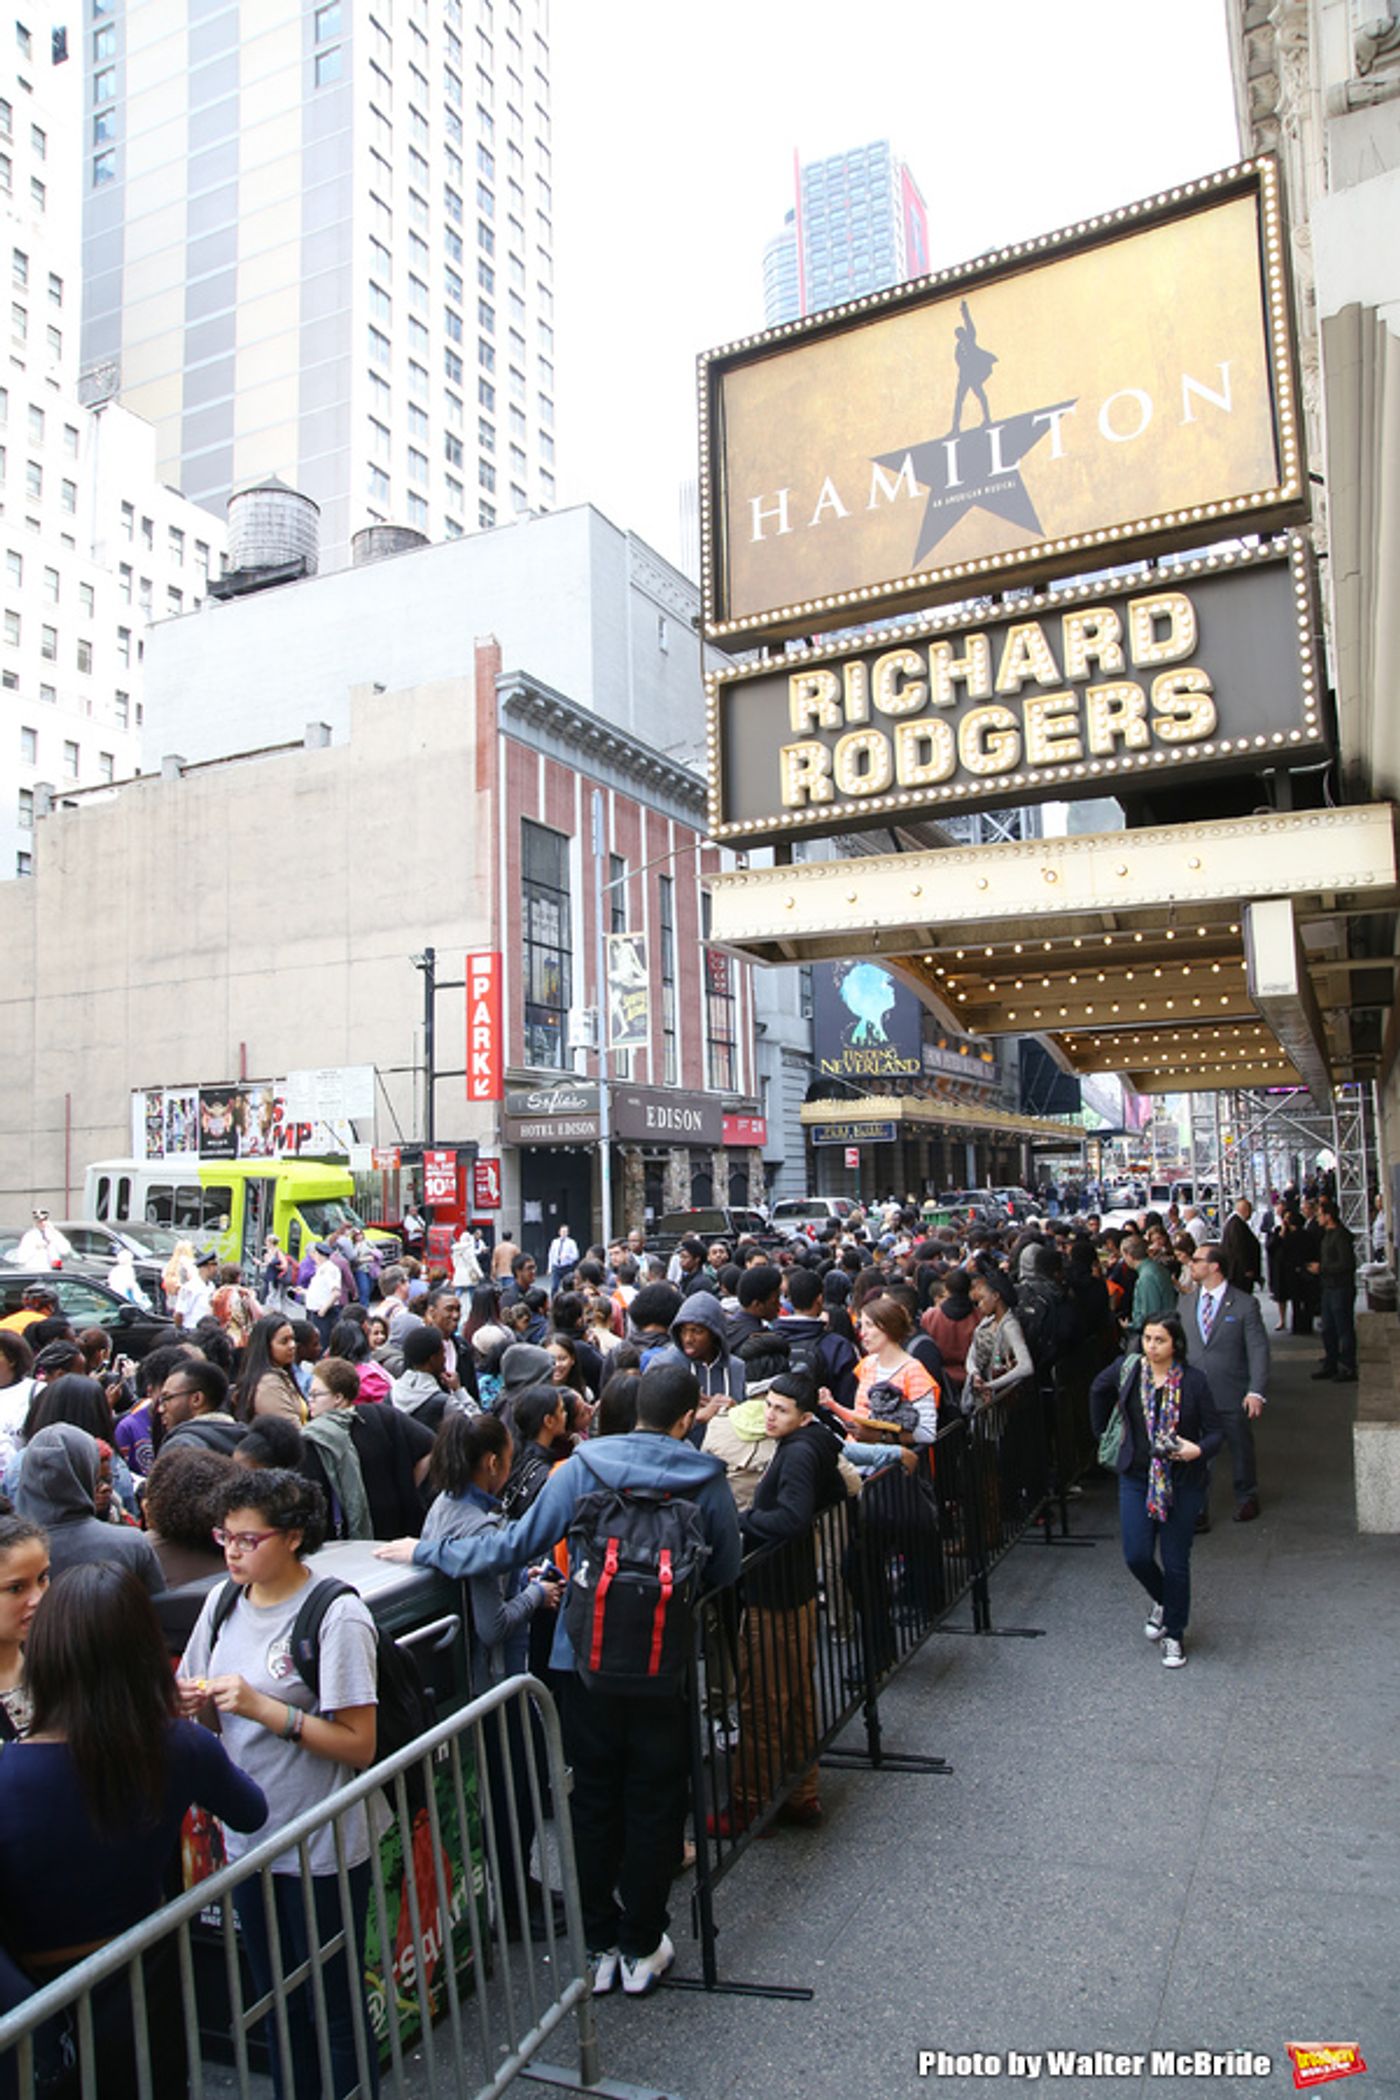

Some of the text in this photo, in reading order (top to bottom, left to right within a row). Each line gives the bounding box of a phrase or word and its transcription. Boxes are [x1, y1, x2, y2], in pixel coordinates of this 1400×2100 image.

[747, 361, 1233, 543] HAMILTON
[788, 592, 1197, 733] RICHARD
[780, 667, 1217, 808] RODGERS
[472, 976, 491, 1075] PARK
[842, 1047, 898, 1063] FINDING
[820, 1057, 920, 1076] NEVERLAND
[520, 1122, 597, 1137] HOTEL EDISON
[645, 1105, 703, 1131] EDISON
